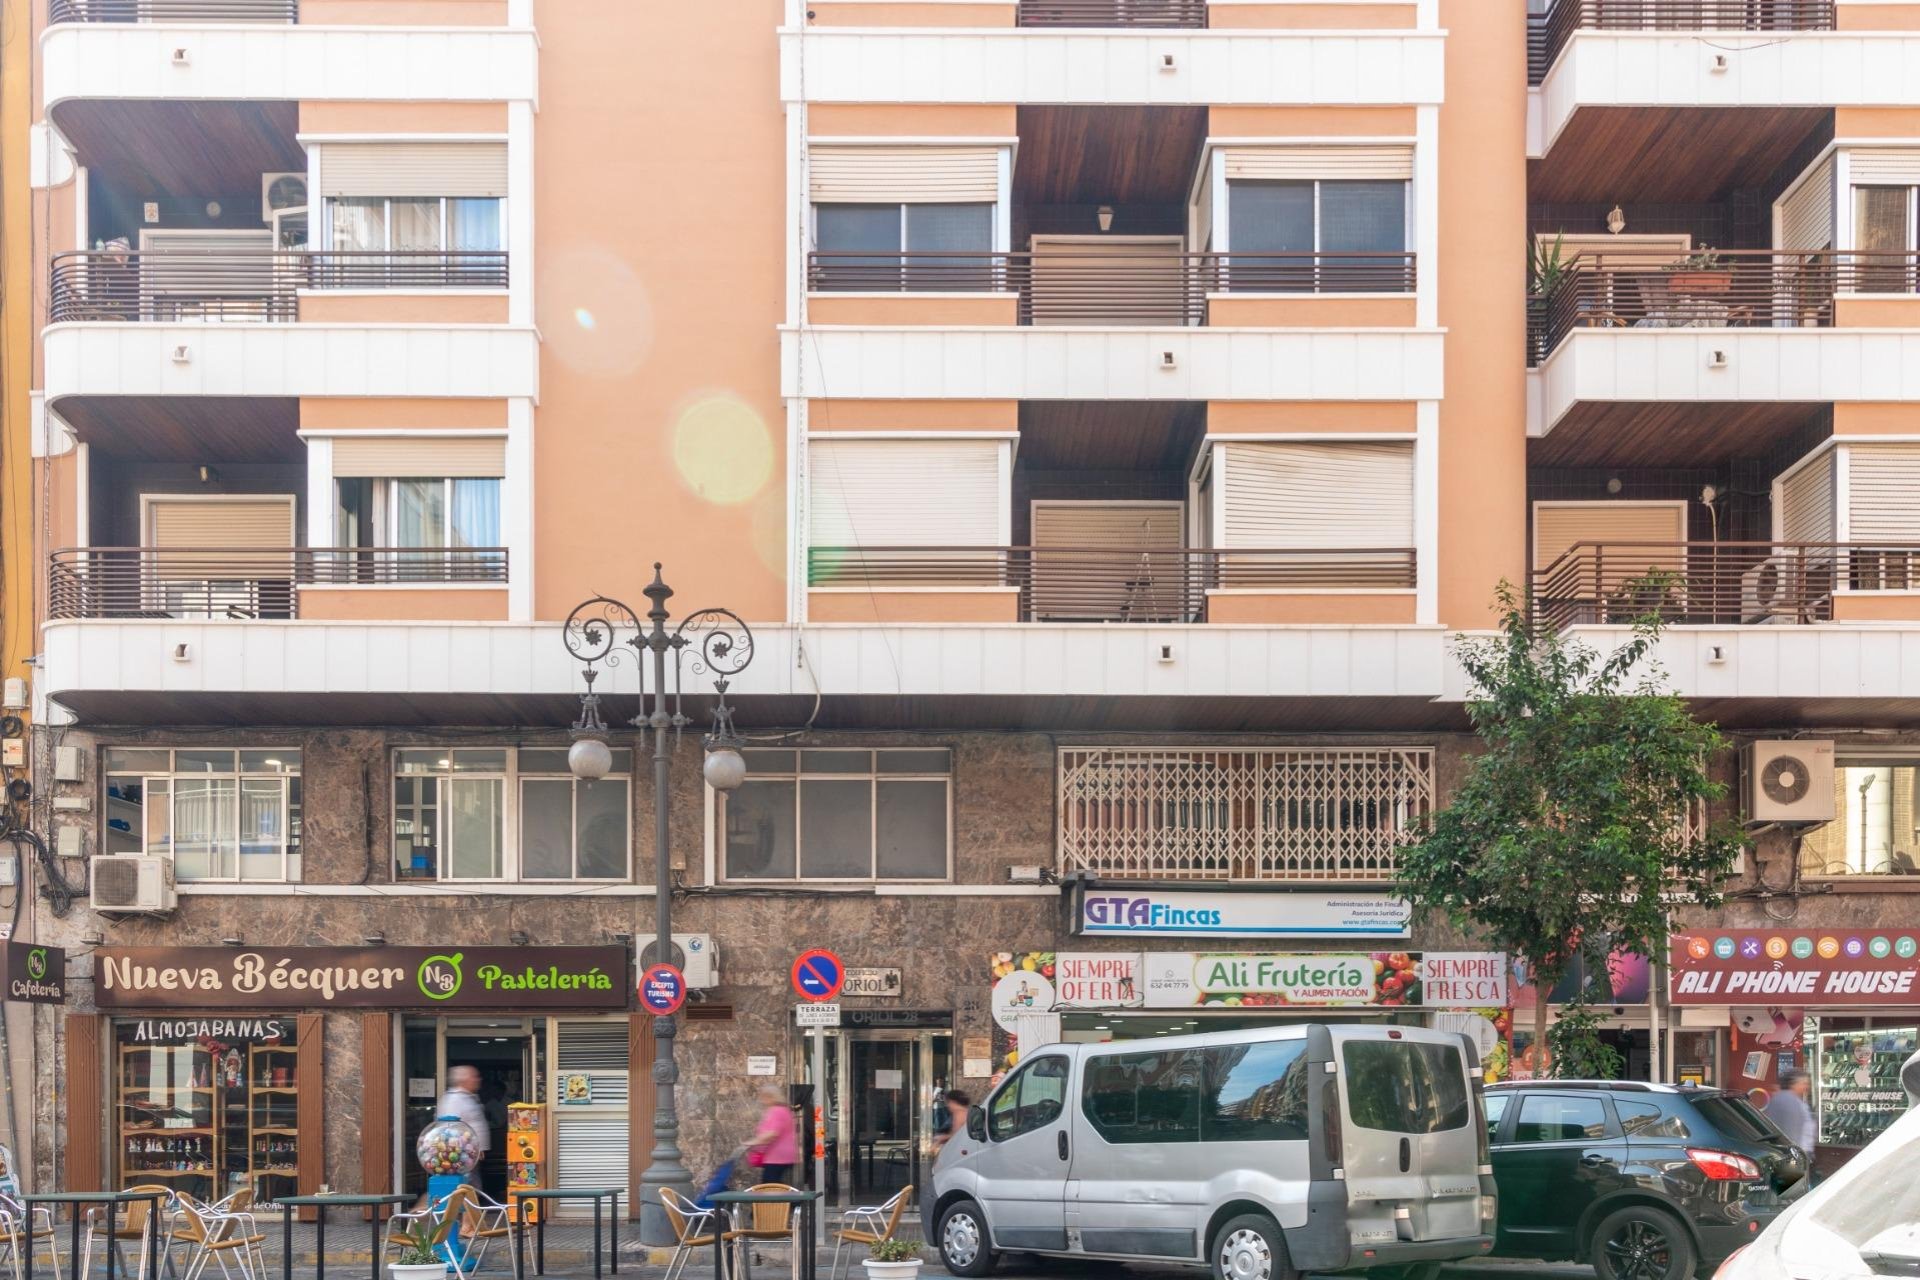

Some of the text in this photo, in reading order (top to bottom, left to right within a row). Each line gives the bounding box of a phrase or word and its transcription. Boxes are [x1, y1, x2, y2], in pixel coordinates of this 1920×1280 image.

[103, 952, 405, 1001] Nueva Bécquer
[477, 964, 613, 991] Pastelería
[1062, 959, 1133, 979] SIEMPRE
[1207, 961, 1363, 988] Ali Frutería
[1427, 959, 1500, 978] SIEMPRE
[12, 979, 61, 999] Cafetería
[843, 979, 888, 992] ORIOL
[1062, 981, 1135, 1001] OFERTA
[1427, 981, 1500, 1000] FRESCA
[1677, 970, 1917, 995] ALI PHONE HOUSE
[1293, 988, 1299, 998] Y
[135, 1019, 282, 1042] ALMOJABANAS
